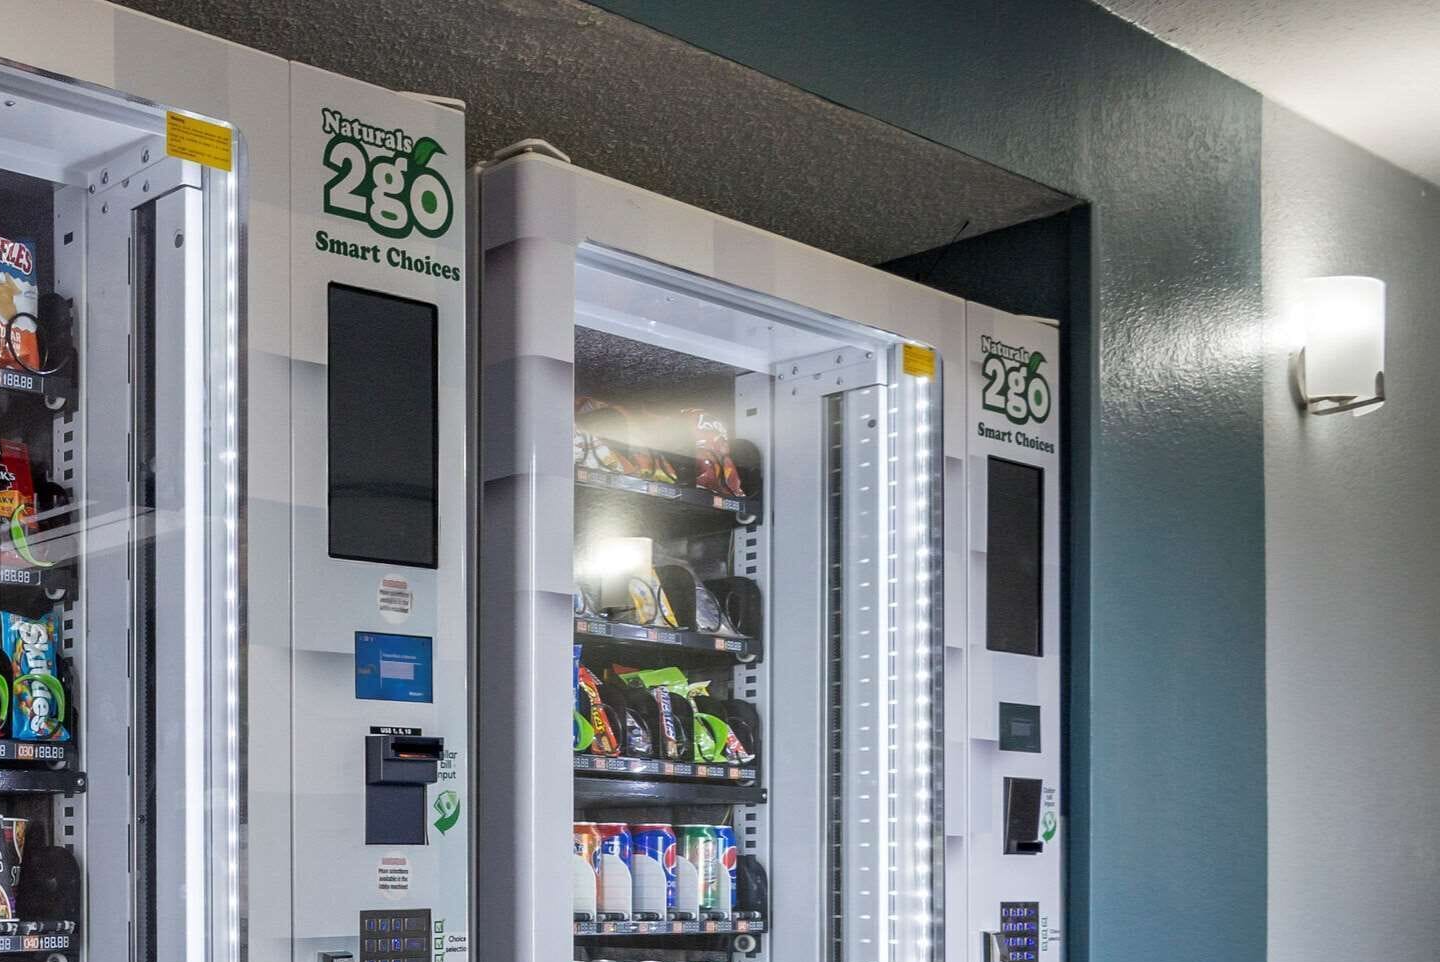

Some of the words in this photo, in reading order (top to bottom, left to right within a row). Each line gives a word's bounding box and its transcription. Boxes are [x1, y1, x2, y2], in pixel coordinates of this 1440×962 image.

[322, 108, 413, 153] Naturals
[323, 135, 454, 239] 2go
[315, 230, 381, 263] Smart
[386, 247, 461, 282] Choices
[981, 335, 1030, 363] Naturals
[978, 421, 1012, 443] Smart
[1015, 432, 1055, 454] Choices
[437, 771, 457, 781] nput
